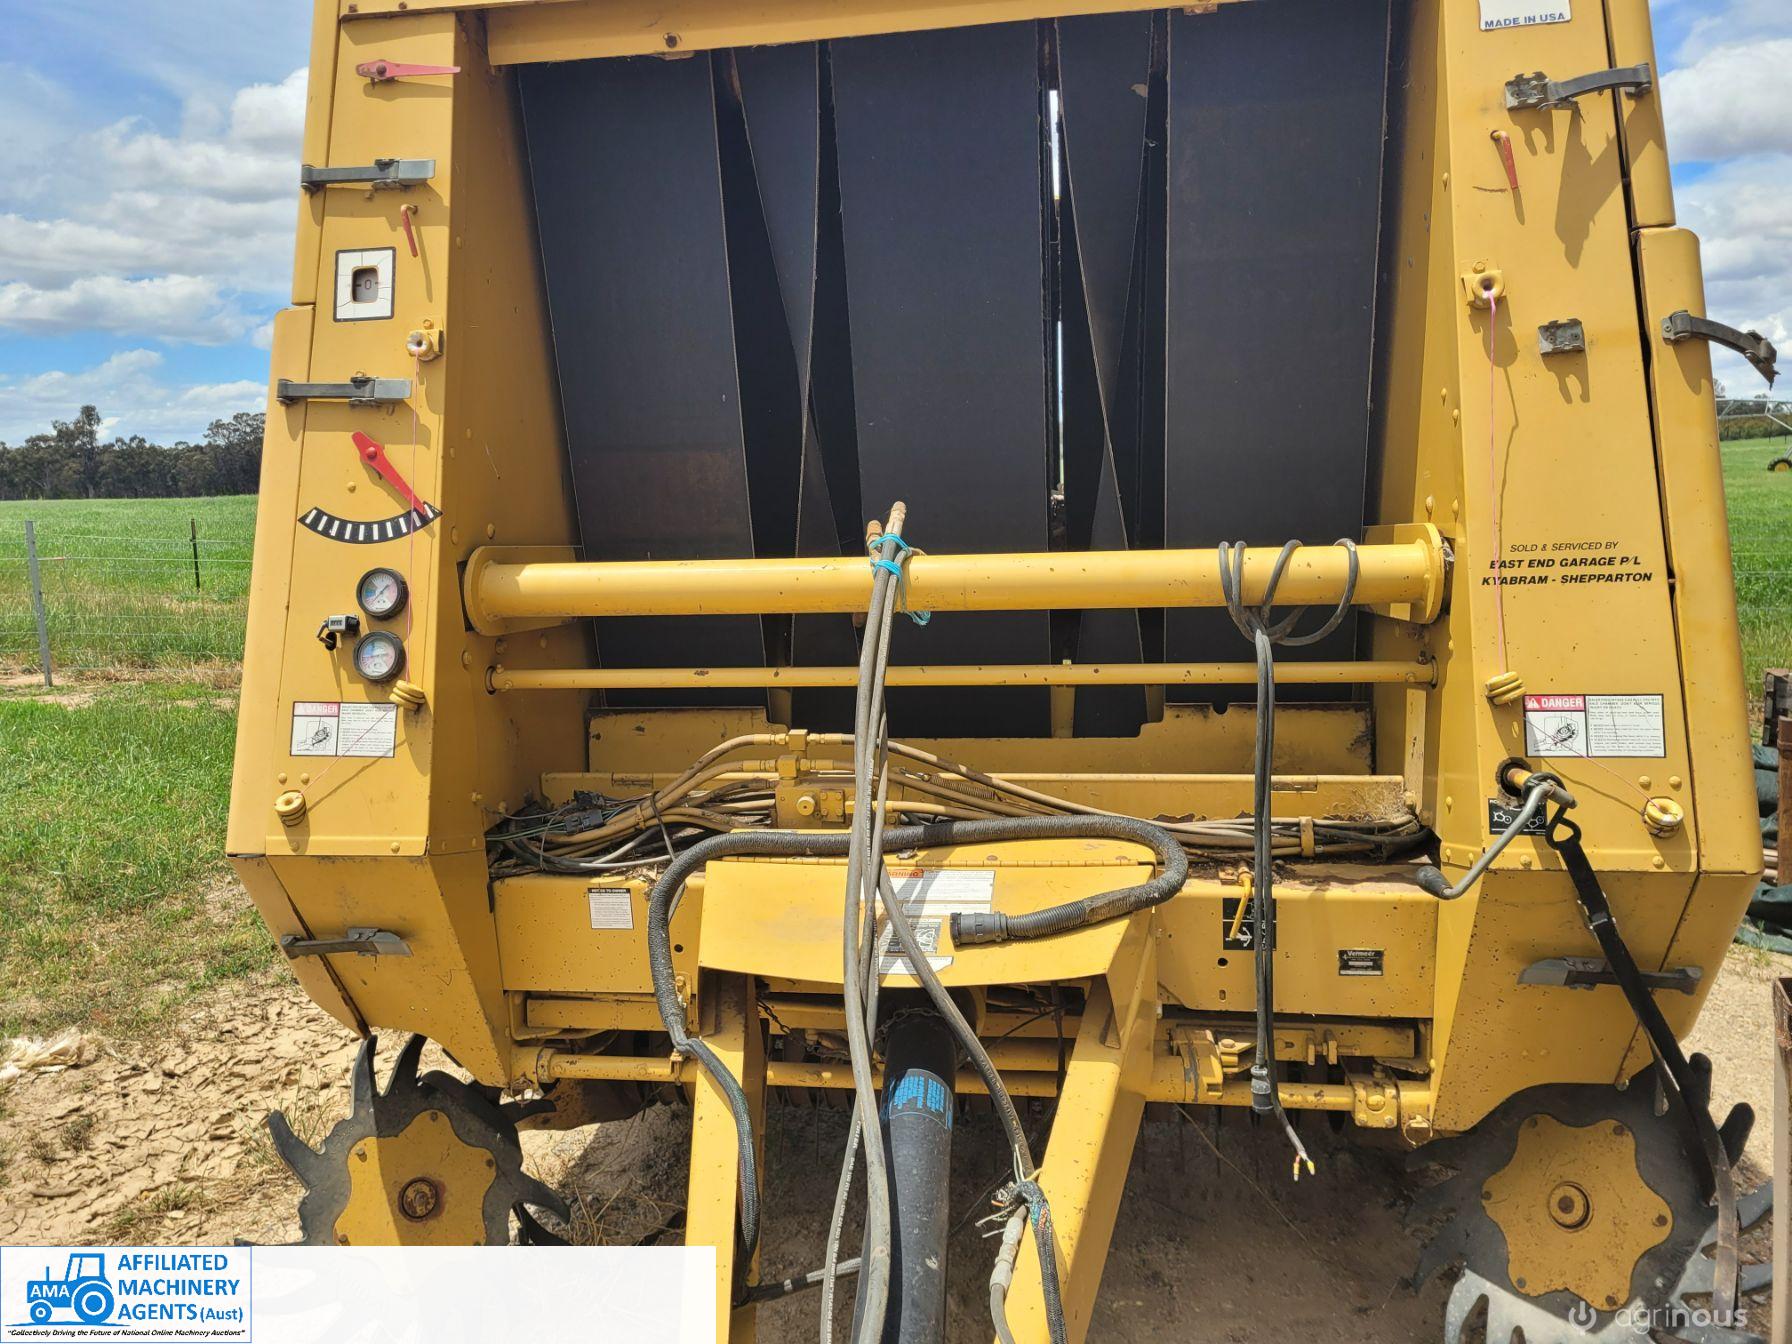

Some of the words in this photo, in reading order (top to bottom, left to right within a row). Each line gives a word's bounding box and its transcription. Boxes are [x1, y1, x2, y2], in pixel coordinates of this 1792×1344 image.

[1484, 17, 1520, 28] MADE
[1524, 15, 1536, 24] IN
[1540, 12, 1565, 22] USA
[1510, 543, 1538, 552] SOLD
[1541, 543, 1547, 551] &
[1551, 541, 1602, 551] SERVICED
[1605, 541, 1619, 550] BY
[1489, 559, 1524, 569] EAST
[1527, 558, 1555, 568] END
[1559, 556, 1616, 567] GARAGE
[1619, 556, 1641, 566] P/L
[1560, 573, 1653, 584] SHEPPARTON
[1541, 697, 1583, 708] DANGER
